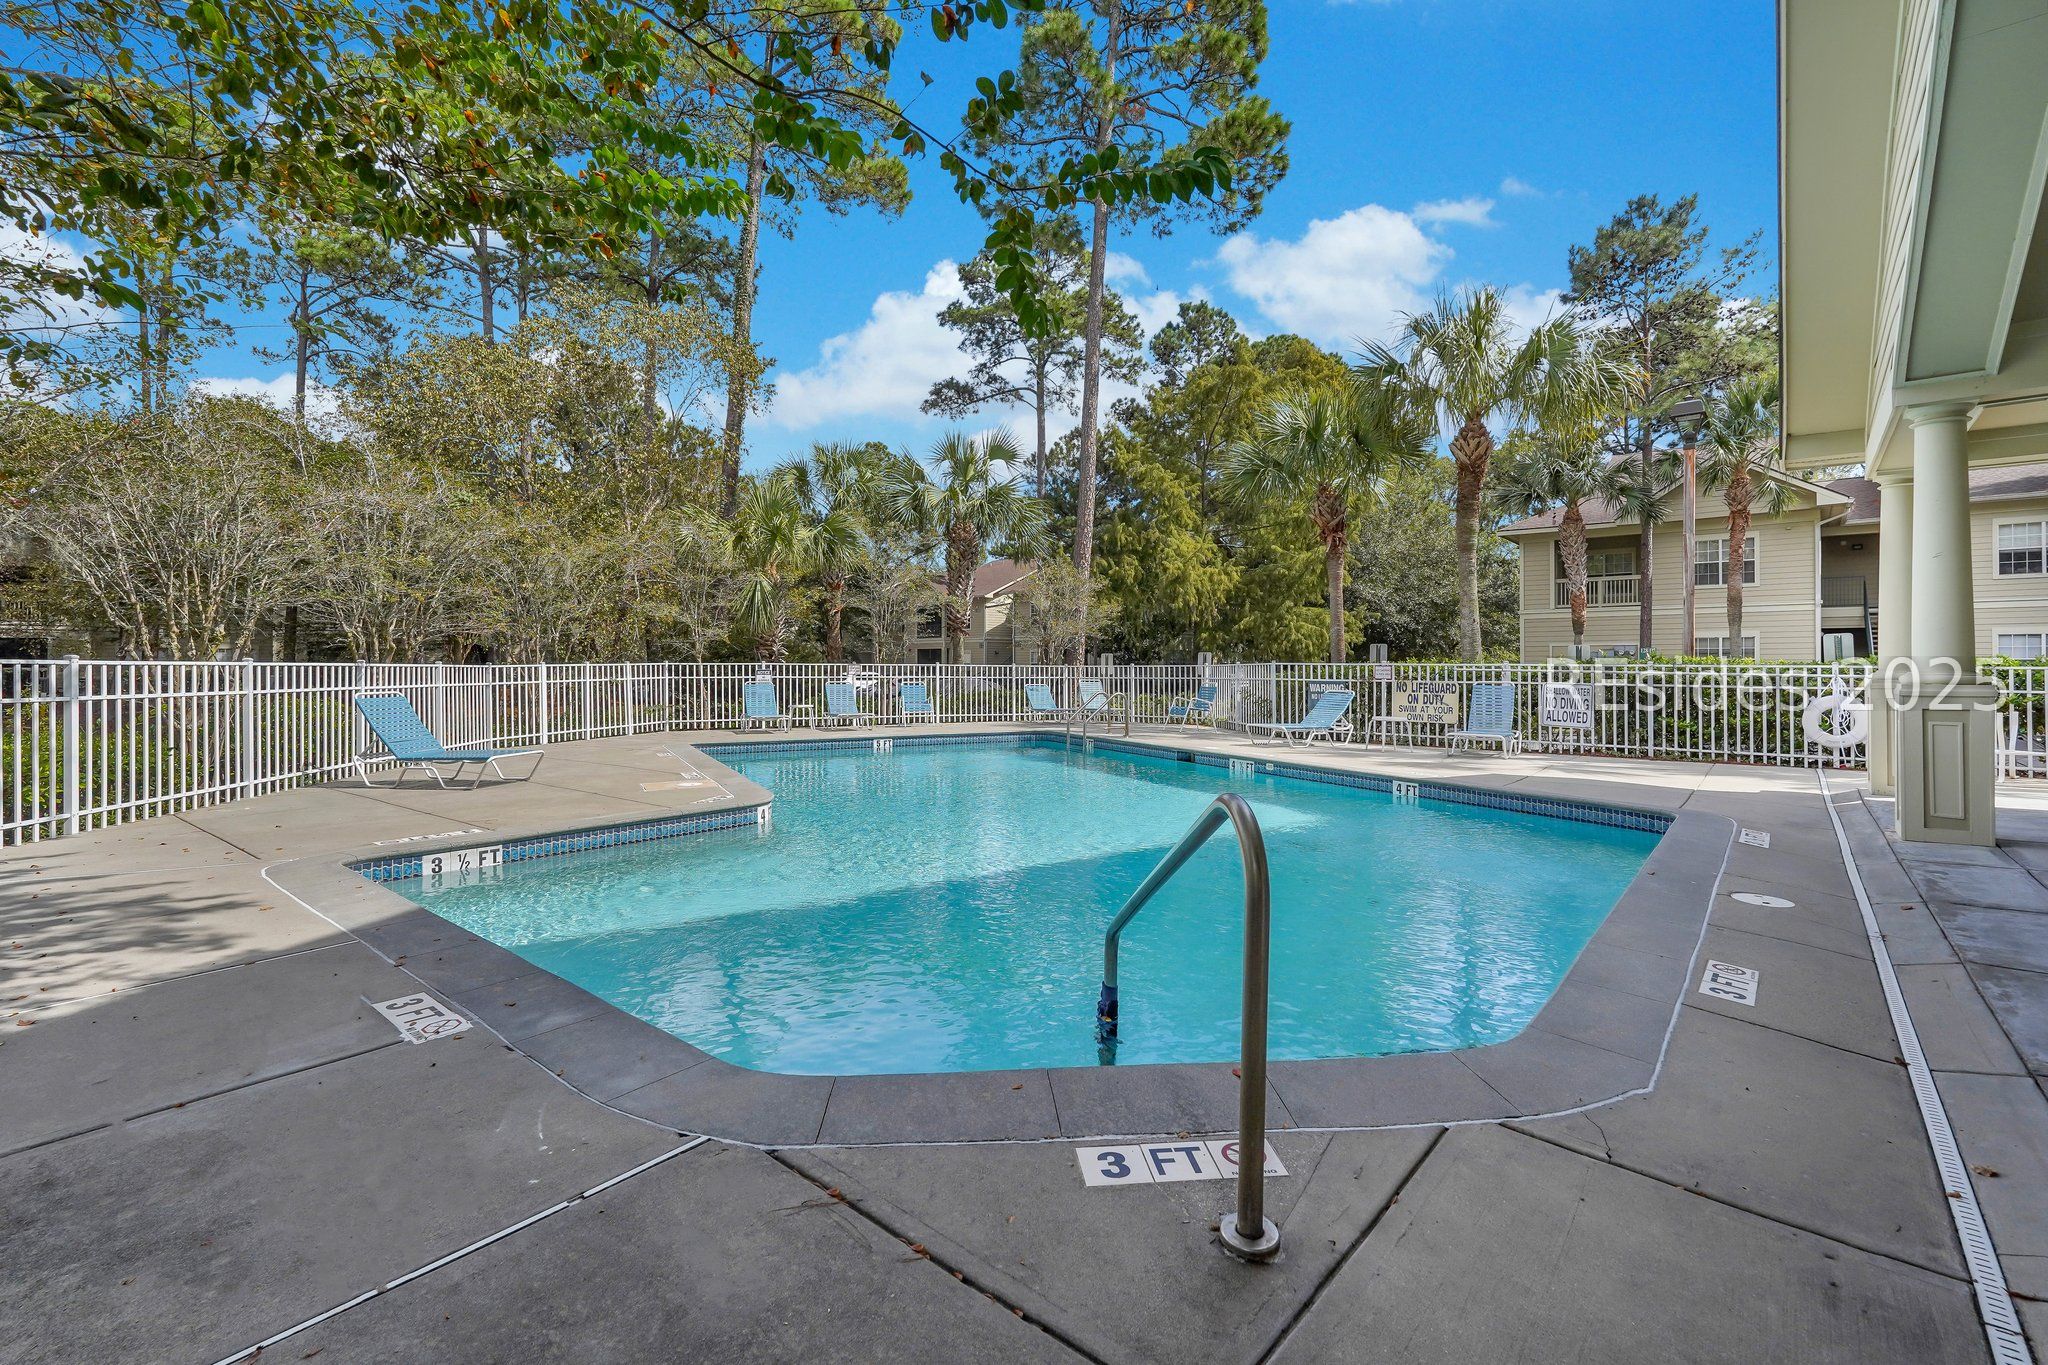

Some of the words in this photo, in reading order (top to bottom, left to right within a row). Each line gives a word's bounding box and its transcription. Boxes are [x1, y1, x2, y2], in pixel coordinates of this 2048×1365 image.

[1310, 683, 1345, 692] WARNING
[1396, 681, 1408, 692] NO
[1411, 682, 1457, 694] LIFEGUARD
[1407, 693, 1419, 704] ON
[1423, 694, 1445, 705] DUTY
[1545, 696, 1557, 709] NO
[1560, 697, 1590, 711] DIVING
[1398, 704, 1417, 712] SWIM
[1420, 705, 1429, 713] AT
[1433, 706, 1454, 714] YOUR
[1407, 713, 1424, 721] OWN
[1428, 714, 1444, 722] RISK
[1545, 709, 1588, 724] ALLOWED
[1396, 783, 1402, 795] 4
[431, 856, 443, 874] 3
[1710, 972, 1750, 991] FT
[1708, 986, 1748, 1000] 3
[385, 997, 425, 1011] 3
[395, 1005, 446, 1024] FT
[1097, 1151, 1131, 1179] 3
[1148, 1146, 1203, 1176] FT
